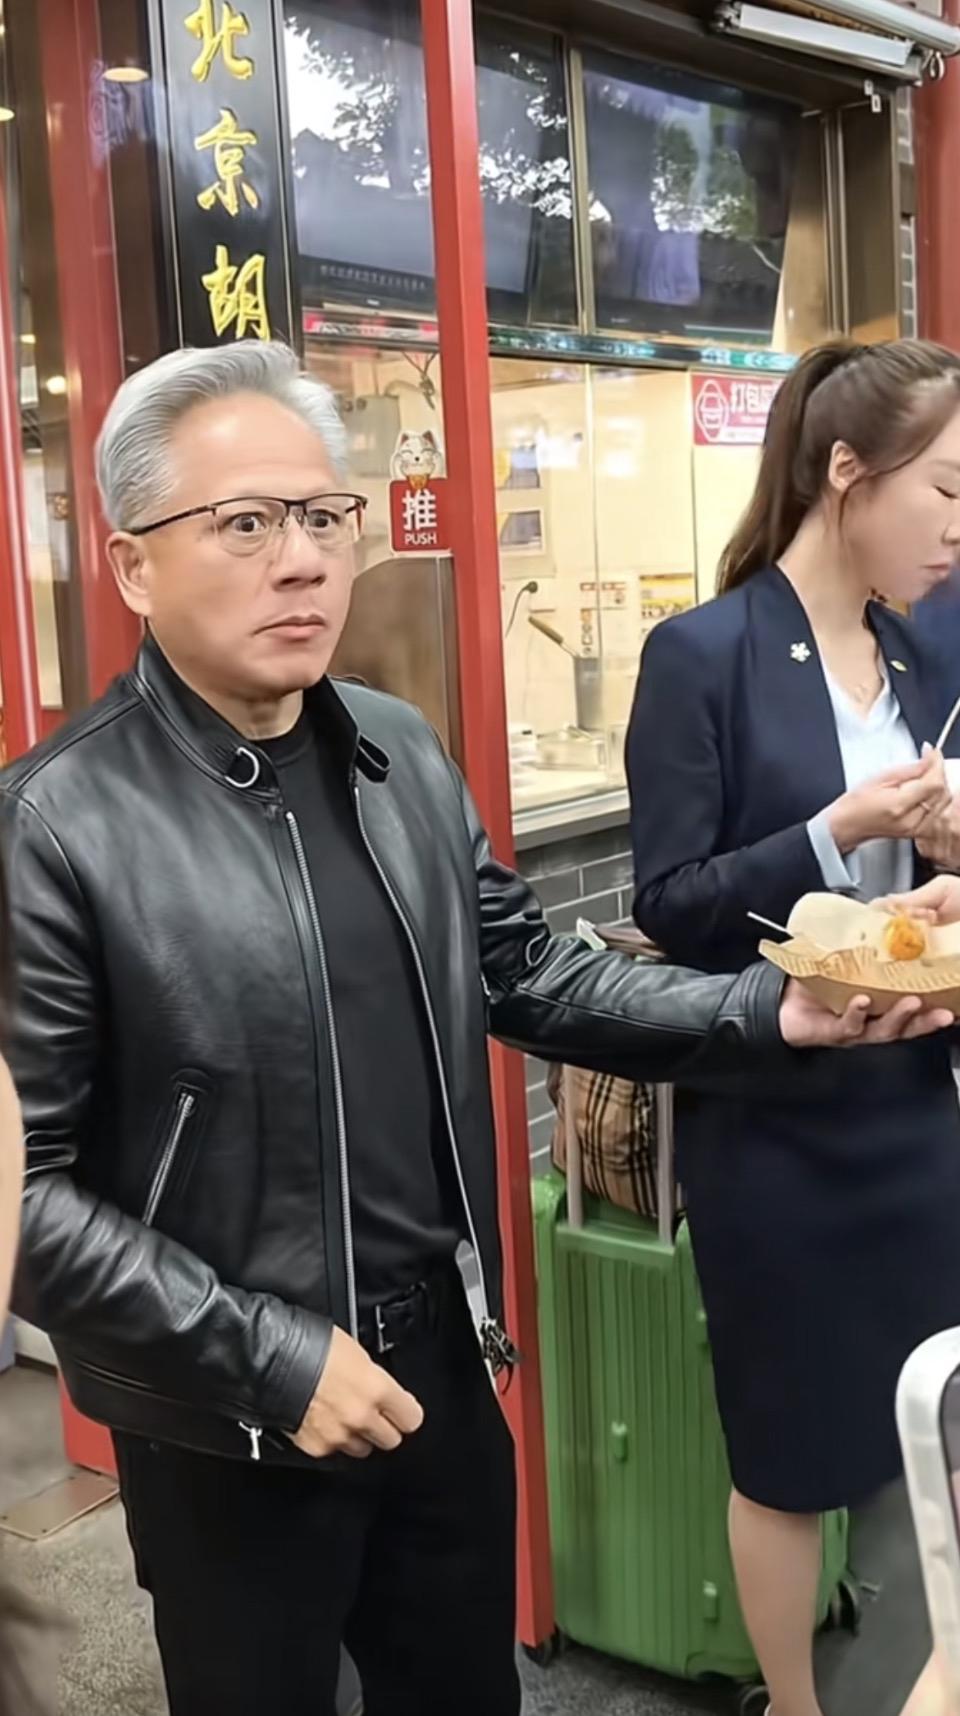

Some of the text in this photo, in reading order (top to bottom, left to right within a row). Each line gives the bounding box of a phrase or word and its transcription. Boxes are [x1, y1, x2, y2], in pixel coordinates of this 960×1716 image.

[184, 0, 270, 342] 北京胡
[402, 488, 438, 531] 推
[404, 532, 438, 545] PUSH
